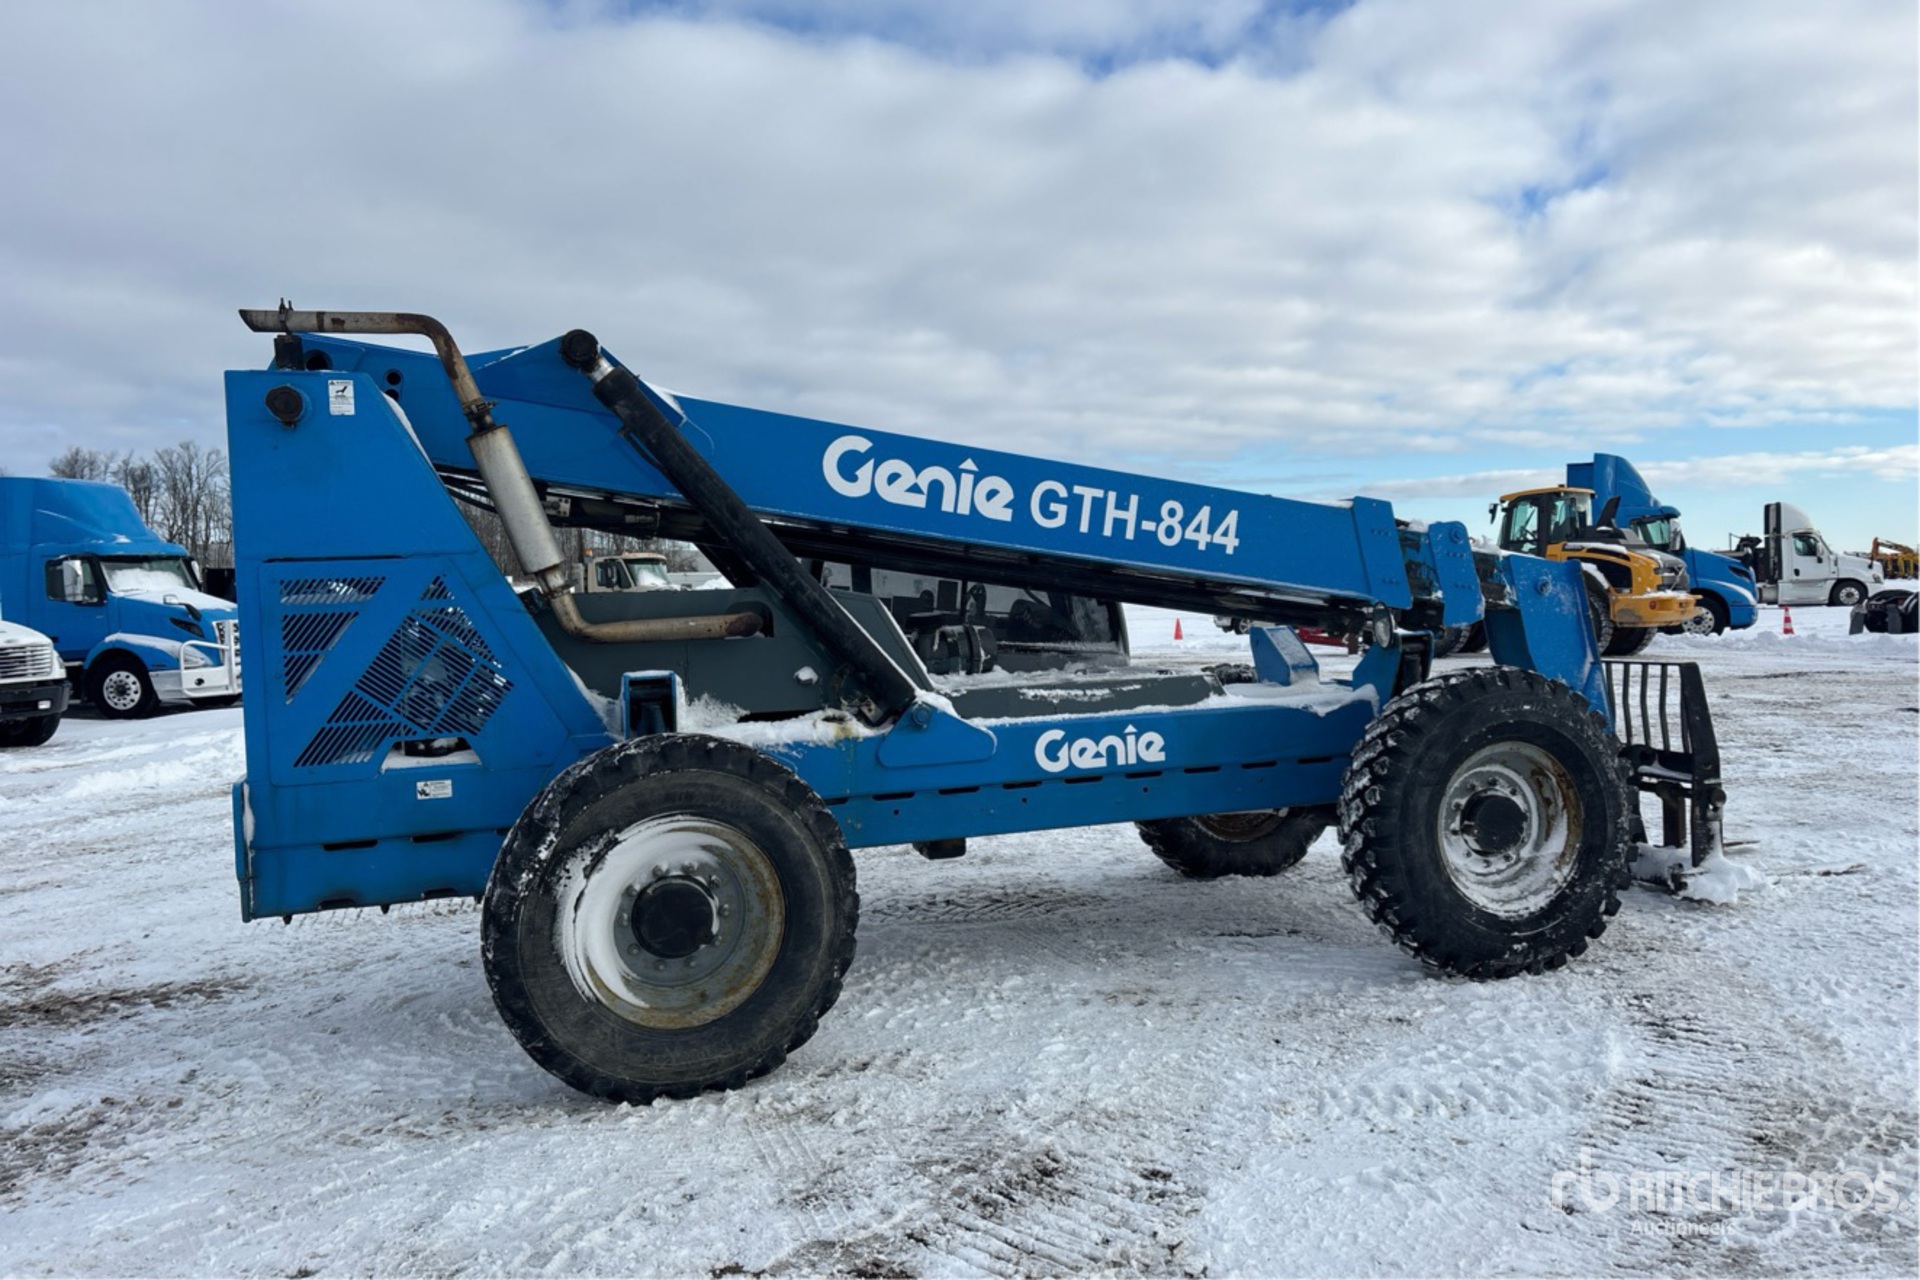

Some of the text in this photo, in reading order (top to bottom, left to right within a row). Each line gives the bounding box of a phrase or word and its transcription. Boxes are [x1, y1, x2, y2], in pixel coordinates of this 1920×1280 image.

[822, 435, 1240, 555] Genie GTH-844
[1034, 724, 1166, 773] Genie
